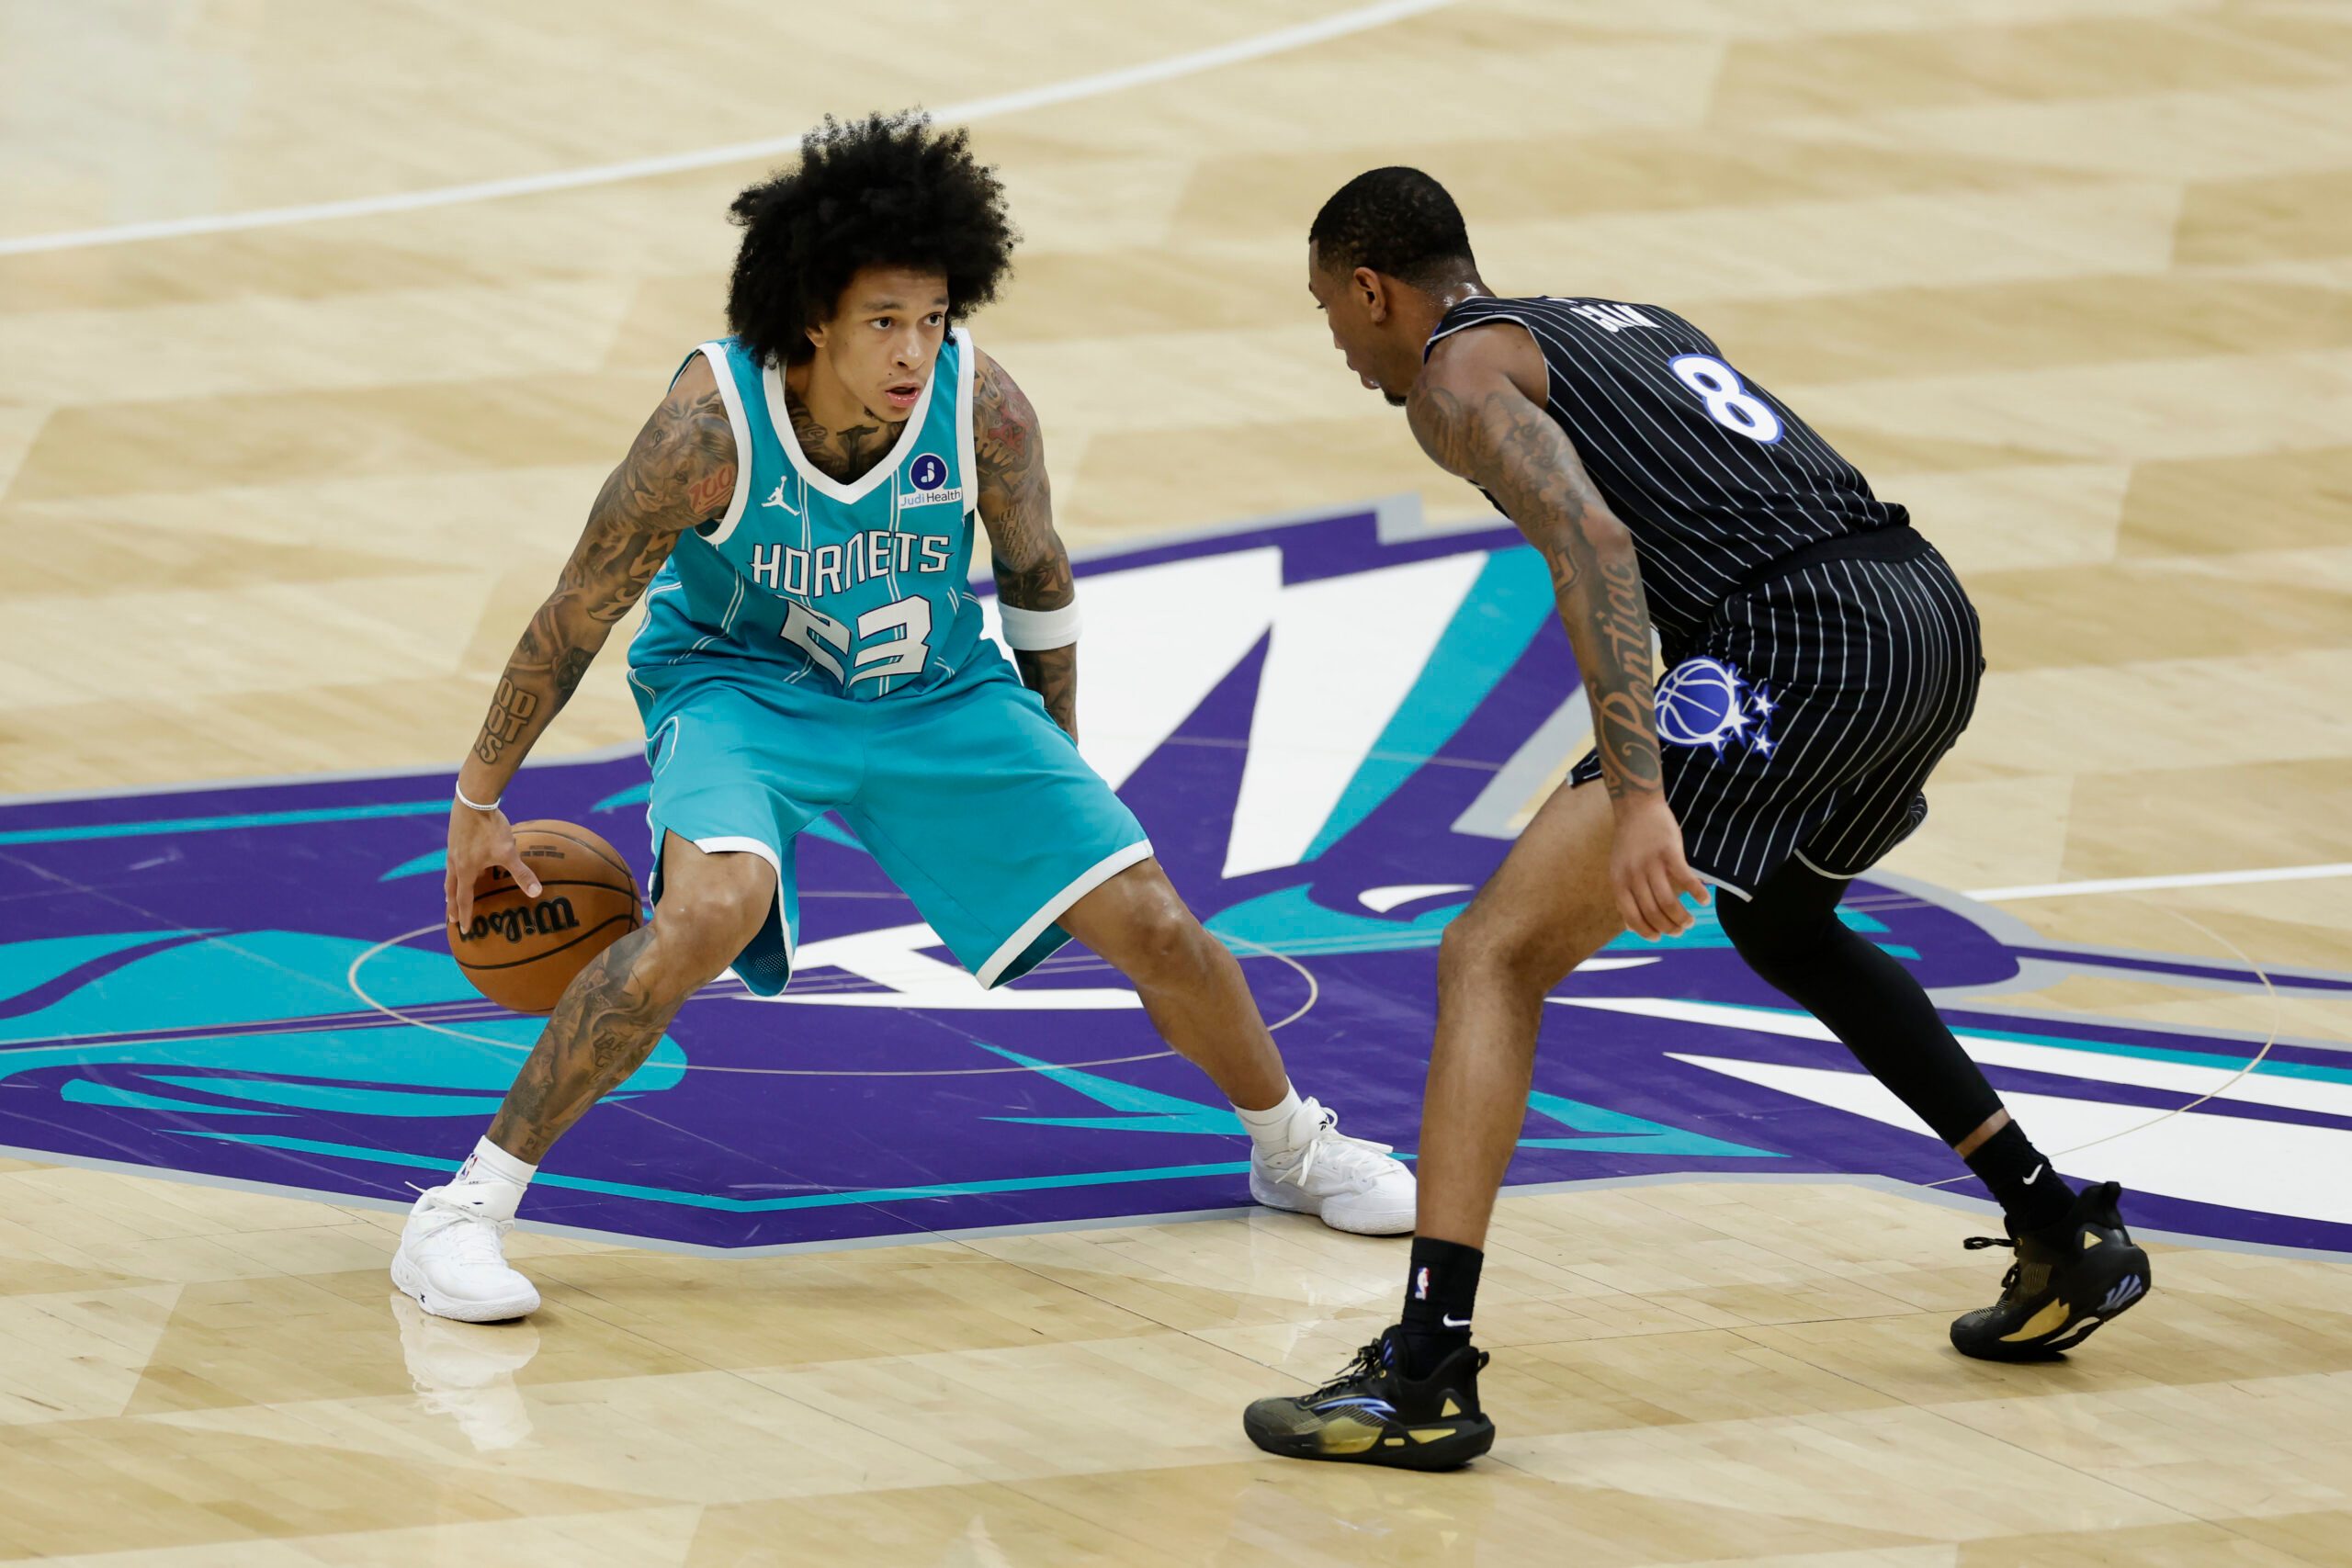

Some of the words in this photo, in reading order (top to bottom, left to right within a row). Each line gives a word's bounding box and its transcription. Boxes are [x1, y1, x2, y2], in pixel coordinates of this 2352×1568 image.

[1668, 353, 1785, 445] 8
[901, 493, 924, 506] Judi
[926, 491, 960, 502] Health
[749, 529, 954, 598] HORNETS
[777, 594, 933, 689] 23
[1590, 560, 1663, 791] Pontiac
